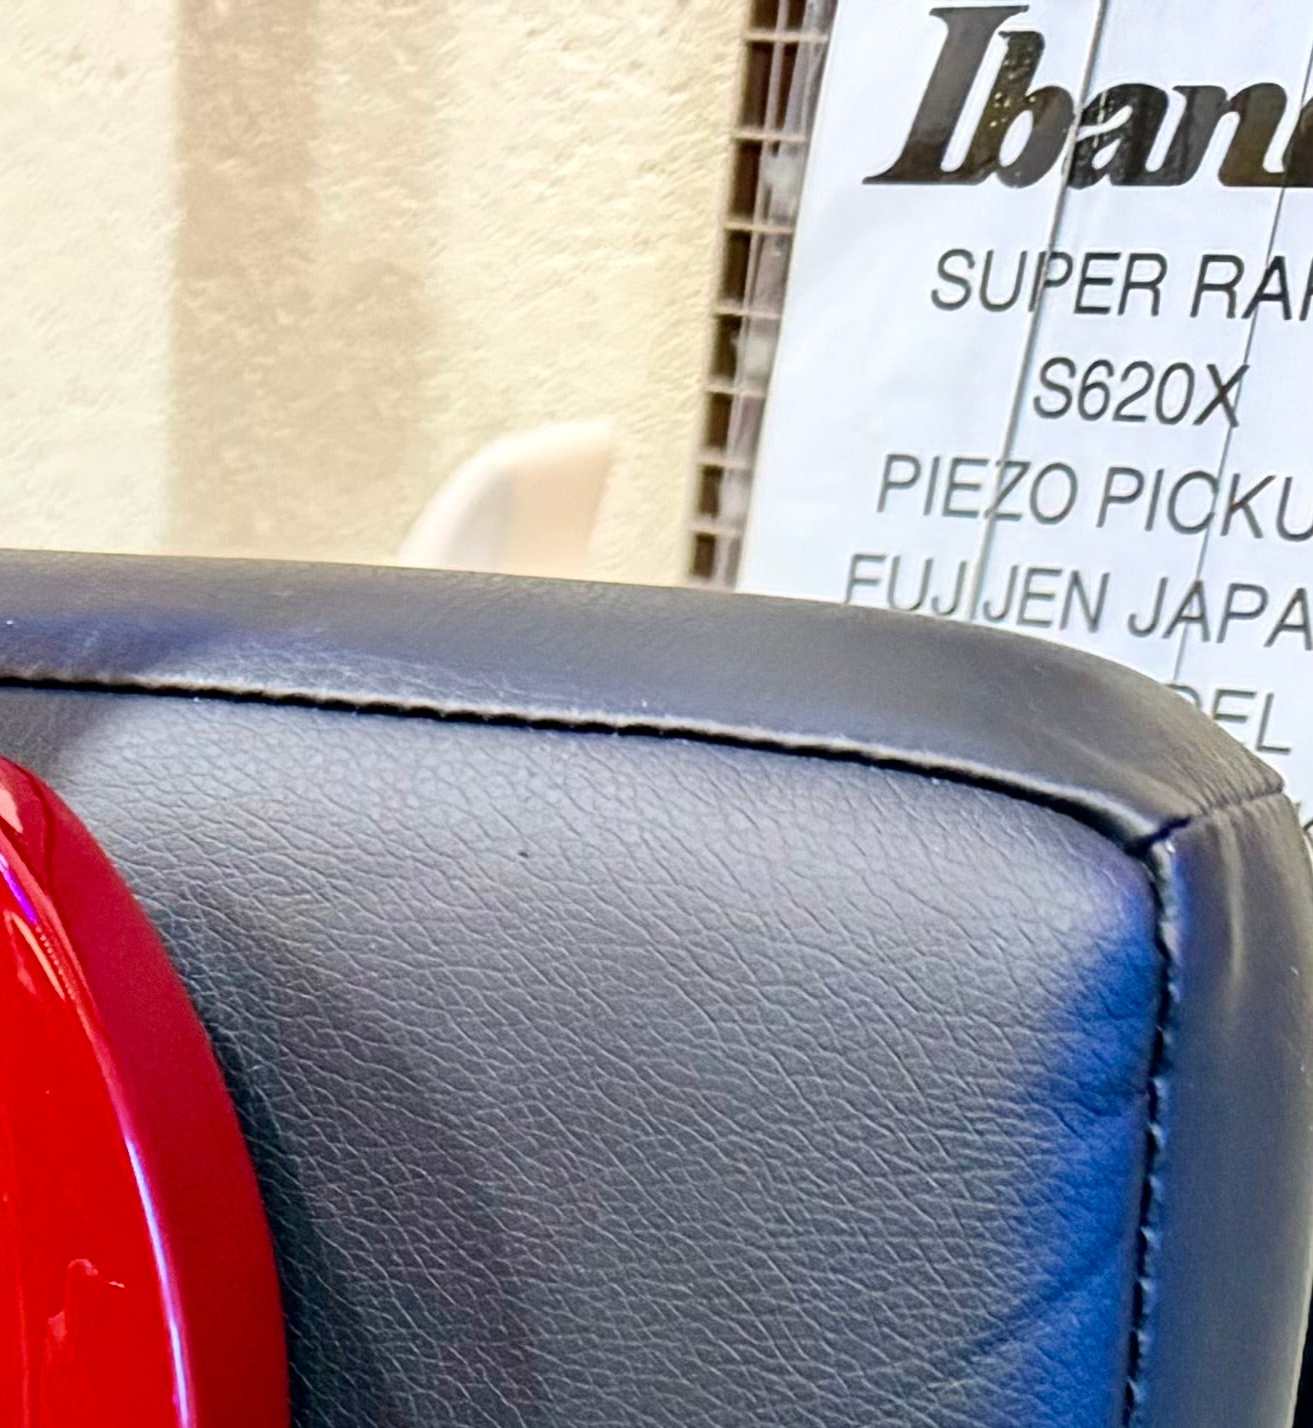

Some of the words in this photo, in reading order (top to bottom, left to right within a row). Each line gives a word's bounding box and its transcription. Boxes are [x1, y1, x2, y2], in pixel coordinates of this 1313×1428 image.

[931, 249, 1168, 316] SUPER
[1032, 356, 1250, 428] S620X
[876, 453, 1078, 527] PIEZO
[1127, 576, 1313, 651] JAPA
